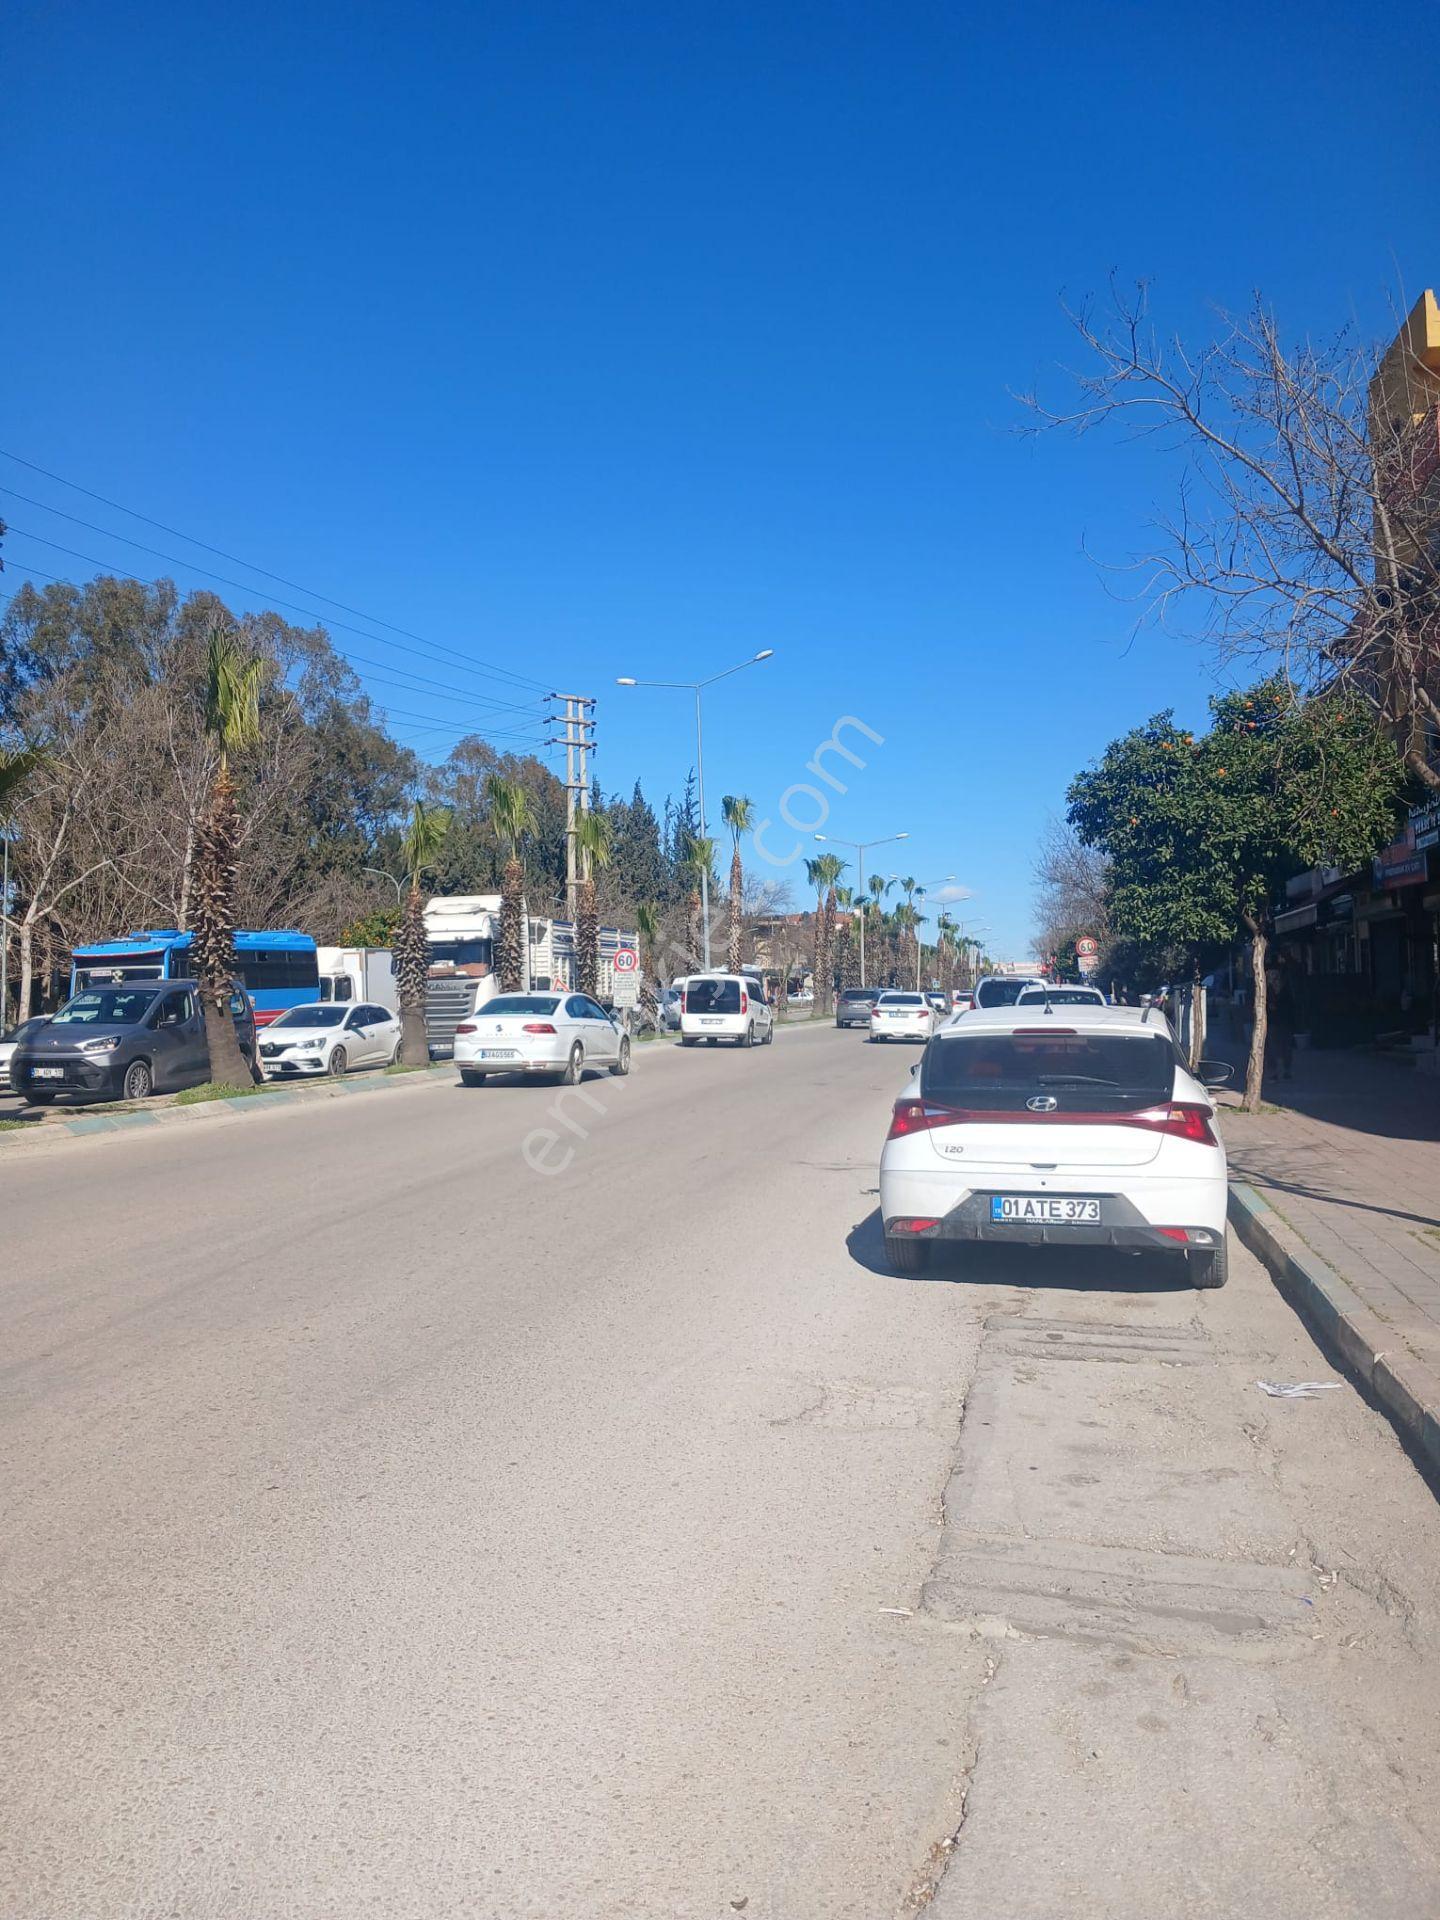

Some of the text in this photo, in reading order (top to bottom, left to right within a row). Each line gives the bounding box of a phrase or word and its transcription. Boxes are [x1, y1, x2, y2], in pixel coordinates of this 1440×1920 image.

[1081, 942, 1093, 952] 60
[618, 954, 633, 966] 60
[1002, 1198, 1099, 1219] 01 ATE 373
